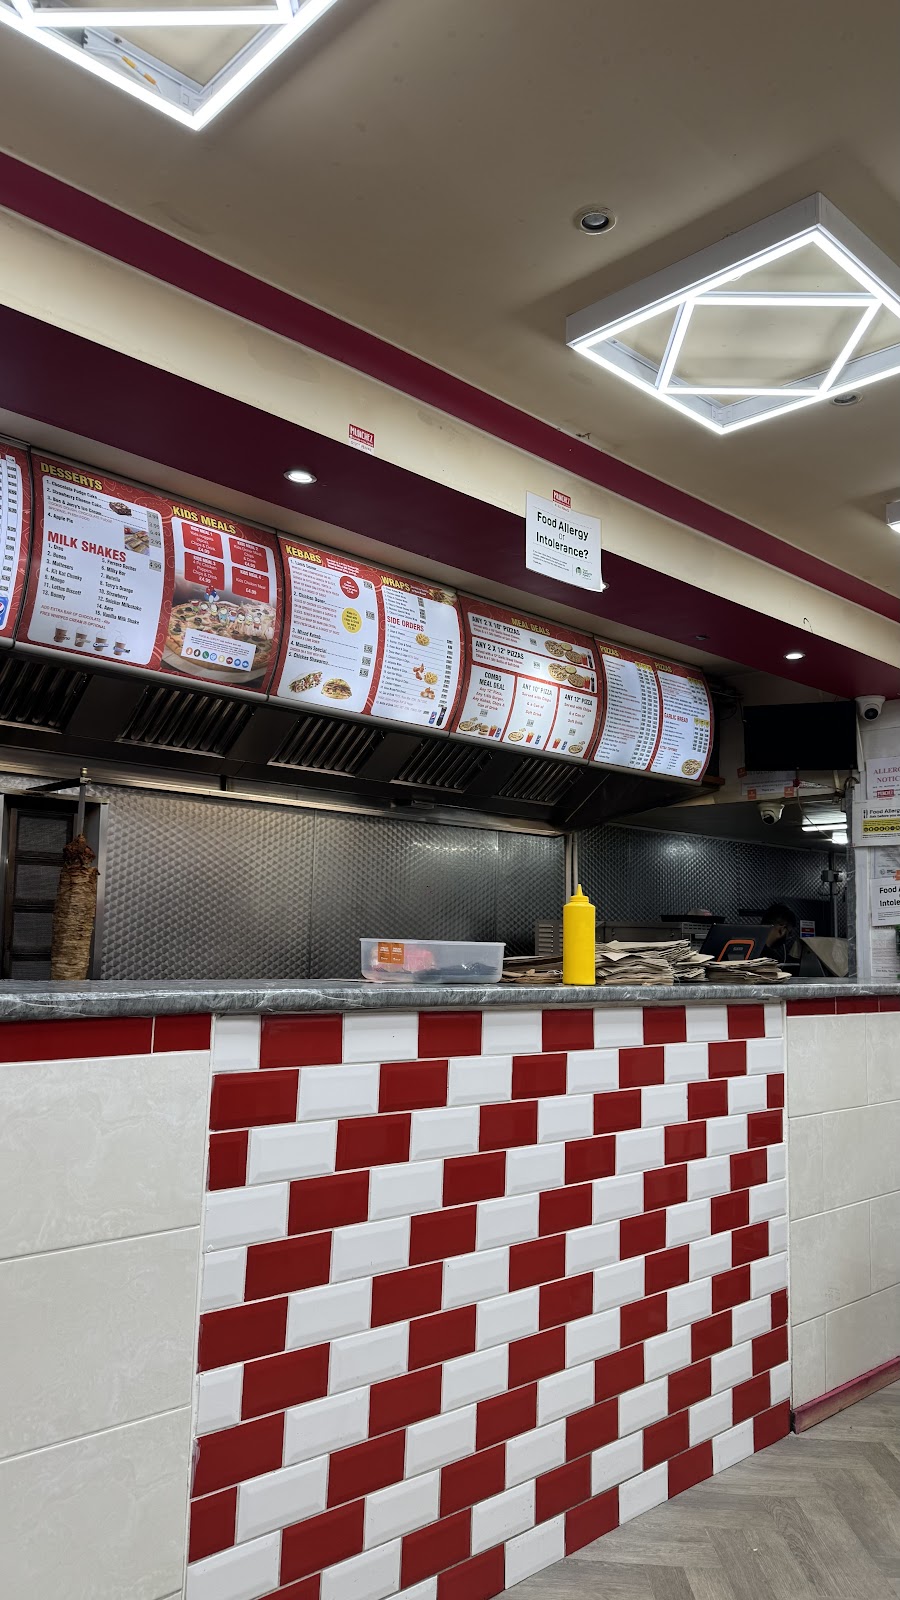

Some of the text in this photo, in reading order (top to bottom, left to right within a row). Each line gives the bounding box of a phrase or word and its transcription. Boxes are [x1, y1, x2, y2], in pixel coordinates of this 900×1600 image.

[41, 463, 102, 491] DESSERTS
[52, 481, 73, 492] Chocolate
[74, 487, 86, 496] Fudge
[52, 489, 75, 500] Strawberry
[76, 496, 90, 505] Cheese
[54, 513, 66, 522] Apple
[172, 506, 236, 534] KIDS MEALS
[537, 512, 588, 541] Food Allergy
[48, 530, 126, 562] MILK SHAKES
[536, 532, 588, 559] Intolerance?
[286, 545, 322, 564] KEBABS
[52, 560, 74, 571] Maltesers
[107, 559, 122, 568] Ferrero
[67, 572, 82, 581] Chunky
[107, 567, 118, 575] Milky
[50, 576, 65, 584] Mango
[106, 574, 120, 582] Nutella
[381, 576, 411, 591] WRAPS
[119, 585, 133, 594] Orange
[50, 591, 66, 600] Bounty
[106, 590, 128, 601] Strawberry
[299, 592, 313, 600] Chicken
[102, 611, 116, 620] Vanilla
[387, 616, 424, 632] SIDE ORDERS
[472, 616, 482, 624] ANY
[503, 626, 520, 636] PIZZAS
[511, 617, 550, 635] MEAL DEALS
[475, 640, 486, 649] ANY
[507, 650, 524, 659] PIZZAS
[600, 645, 619, 657] PIZZAS
[654, 662, 672, 673] PIZZAS
[484, 671, 502, 681] COMBO
[479, 679, 505, 691] MEAL DEAL
[540, 688, 552, 696] PIZZA
[581, 698, 593, 706] PIZZA
[664, 713, 675, 721] GARLIC
